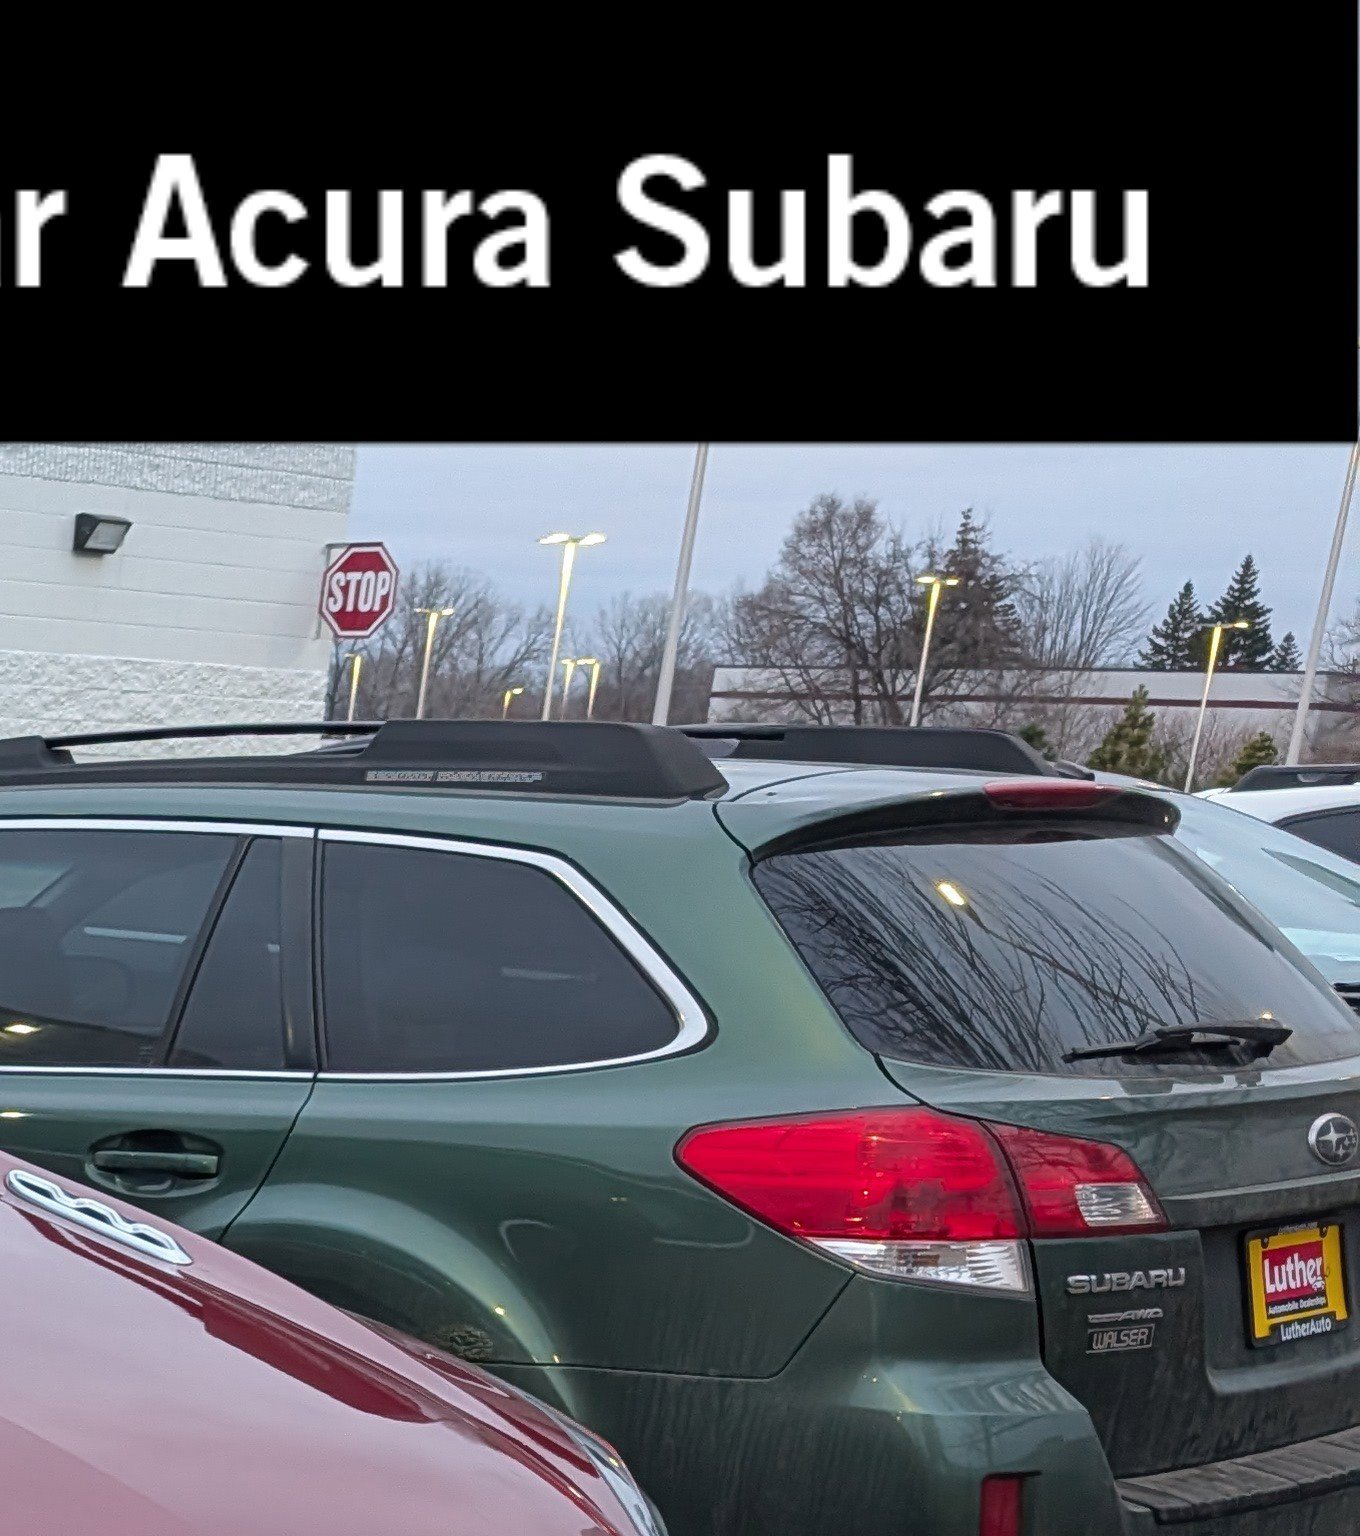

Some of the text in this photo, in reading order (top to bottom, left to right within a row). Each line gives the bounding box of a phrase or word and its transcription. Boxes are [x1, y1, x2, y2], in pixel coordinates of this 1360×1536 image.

[328, 570, 391, 613] STOP
[1066, 1267, 1186, 1295] SUBARU
[1263, 1252, 1323, 1294] Luther
[1092, 1328, 1149, 1351] WALSER
[1280, 1316, 1332, 1342] LutherAuto
